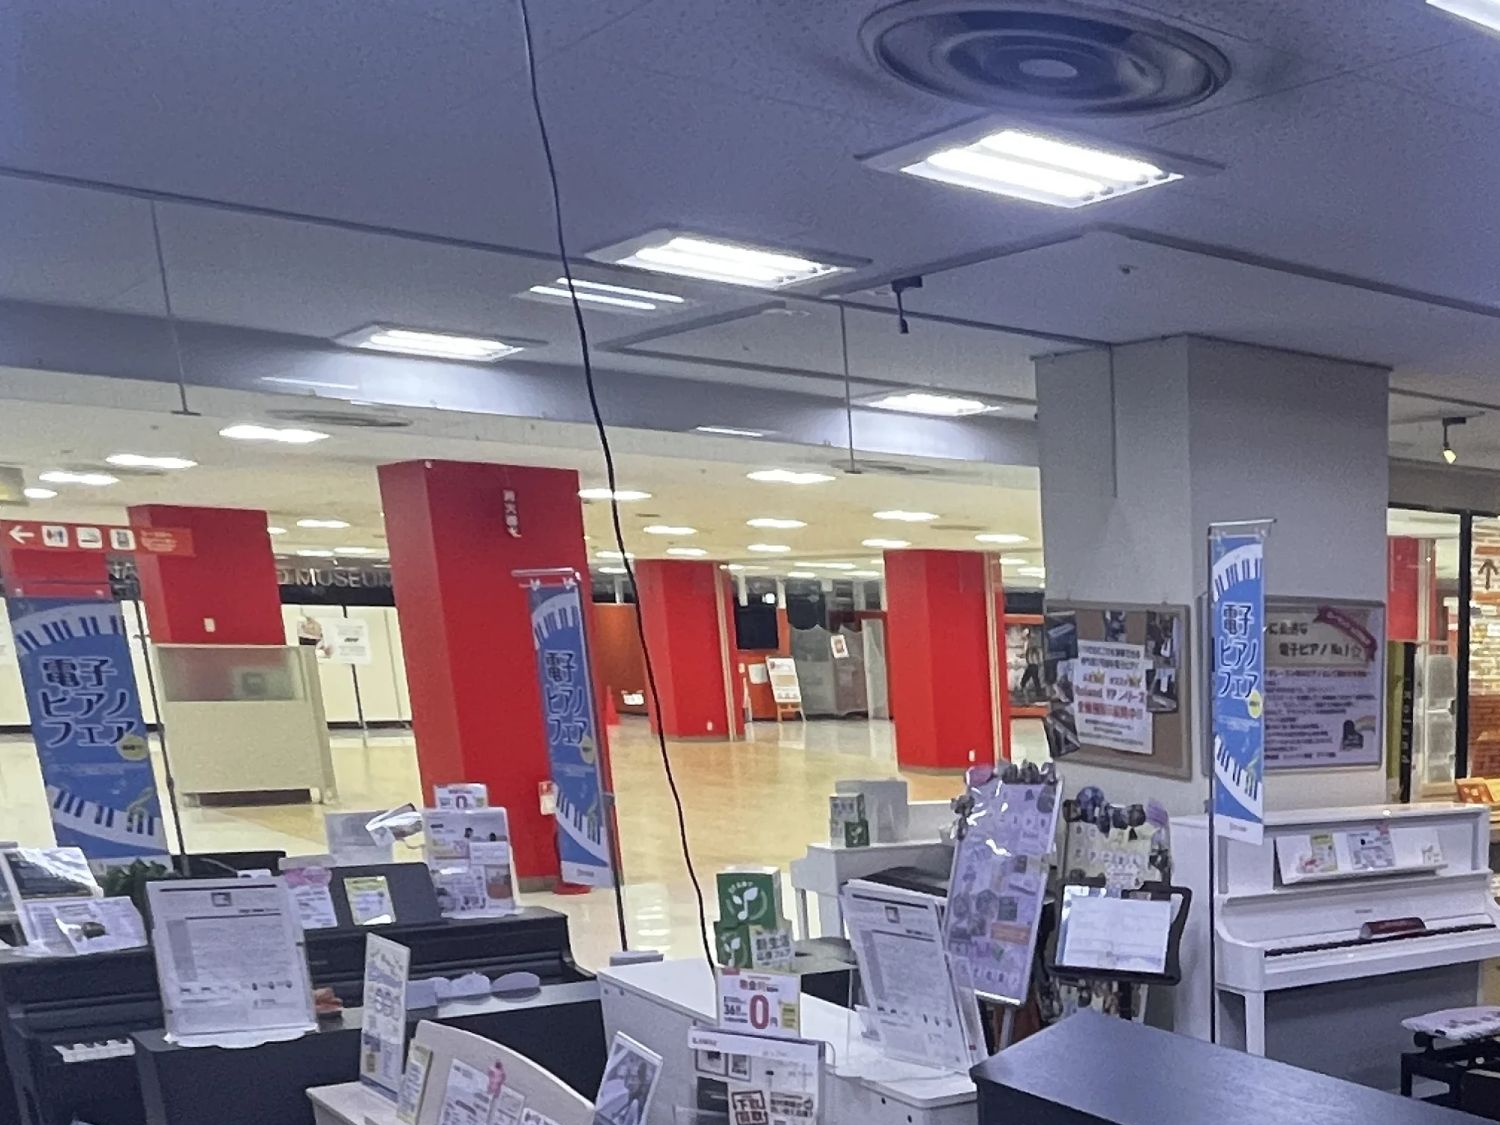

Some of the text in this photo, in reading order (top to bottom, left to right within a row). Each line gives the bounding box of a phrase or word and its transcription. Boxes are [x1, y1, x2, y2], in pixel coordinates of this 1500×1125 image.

[1222, 603, 1254, 635] 電子
[1220, 637, 1258, 667] ピアノ
[43, 656, 117, 689] 電子
[544, 651, 577, 684] 電子
[545, 685, 584, 715] ピアノ
[1218, 671, 1258, 699] フェア
[40, 692, 129, 719] ピアノ
[43, 720, 135, 748] フェア
[547, 715, 588, 746] フェア
